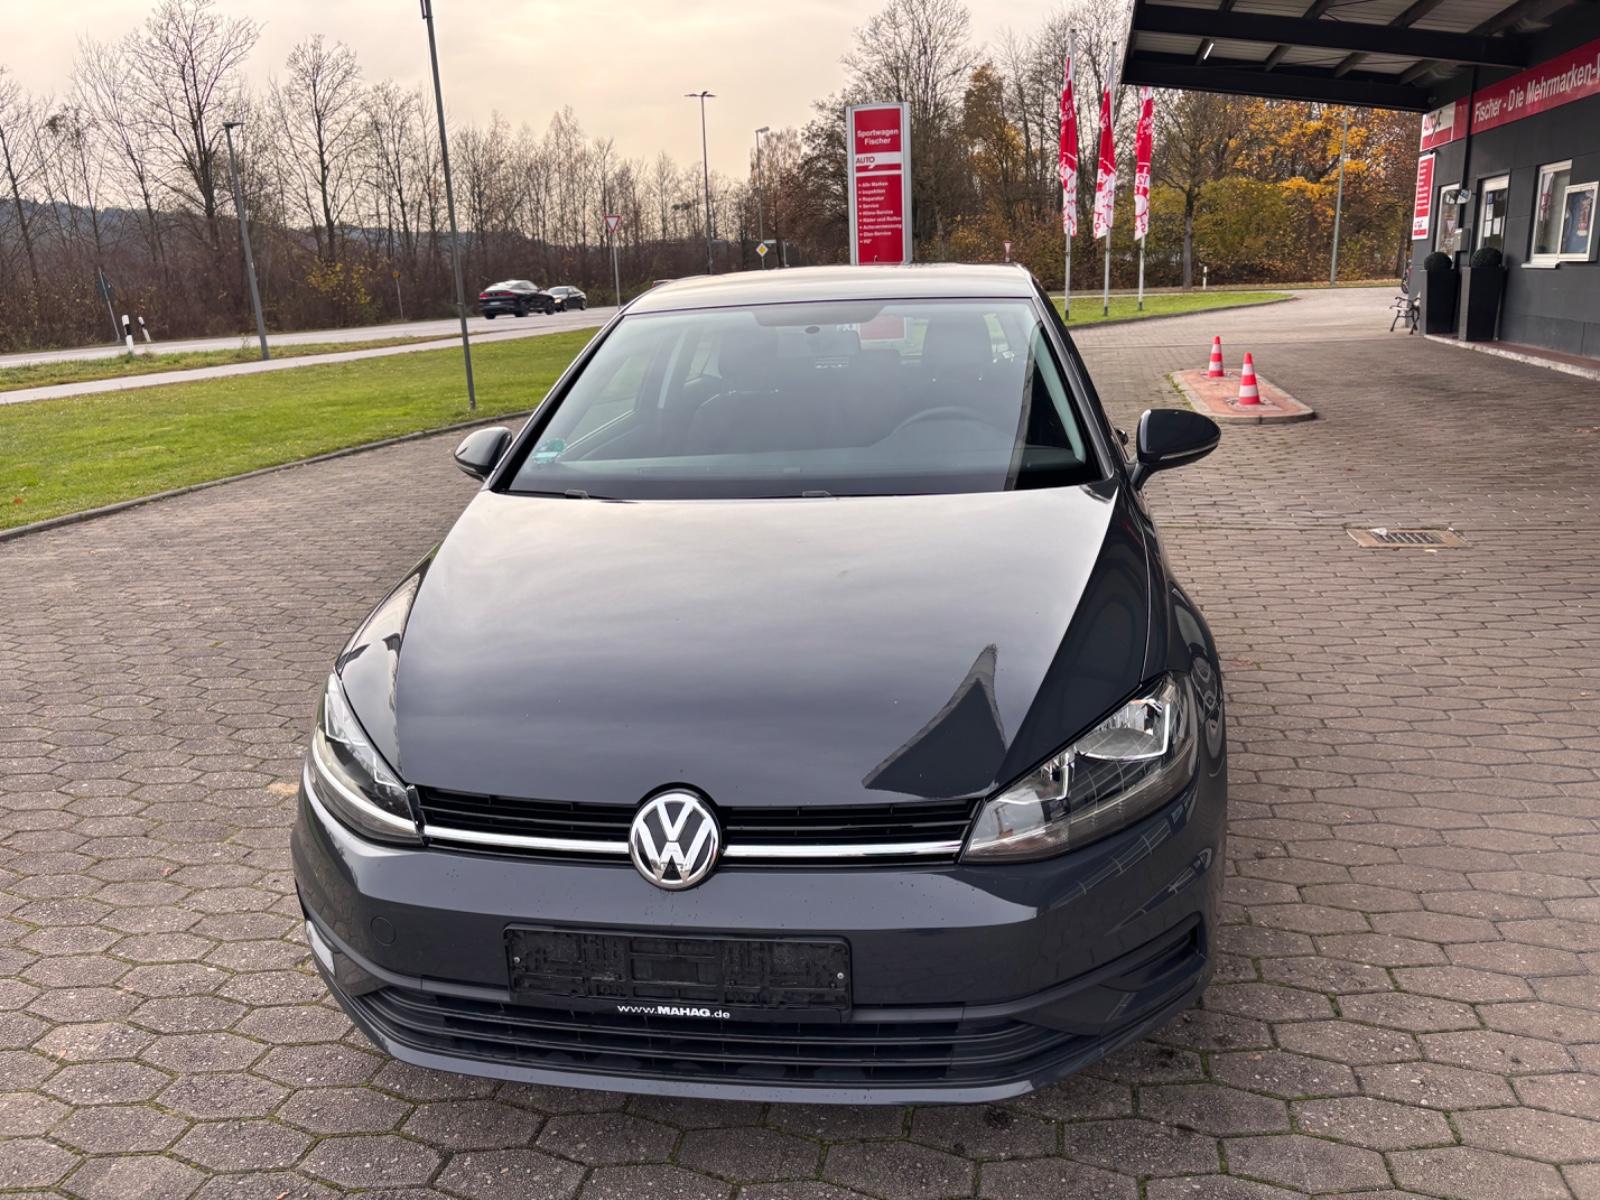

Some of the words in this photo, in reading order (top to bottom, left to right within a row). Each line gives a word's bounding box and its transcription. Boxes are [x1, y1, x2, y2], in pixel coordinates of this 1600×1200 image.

[1474, 98, 1502, 124] Fischer
[1507, 86, 1524, 112] Die
[857, 129, 899, 138] Sportwagen
[617, 1005, 730, 1019] www.MAHAG.de
